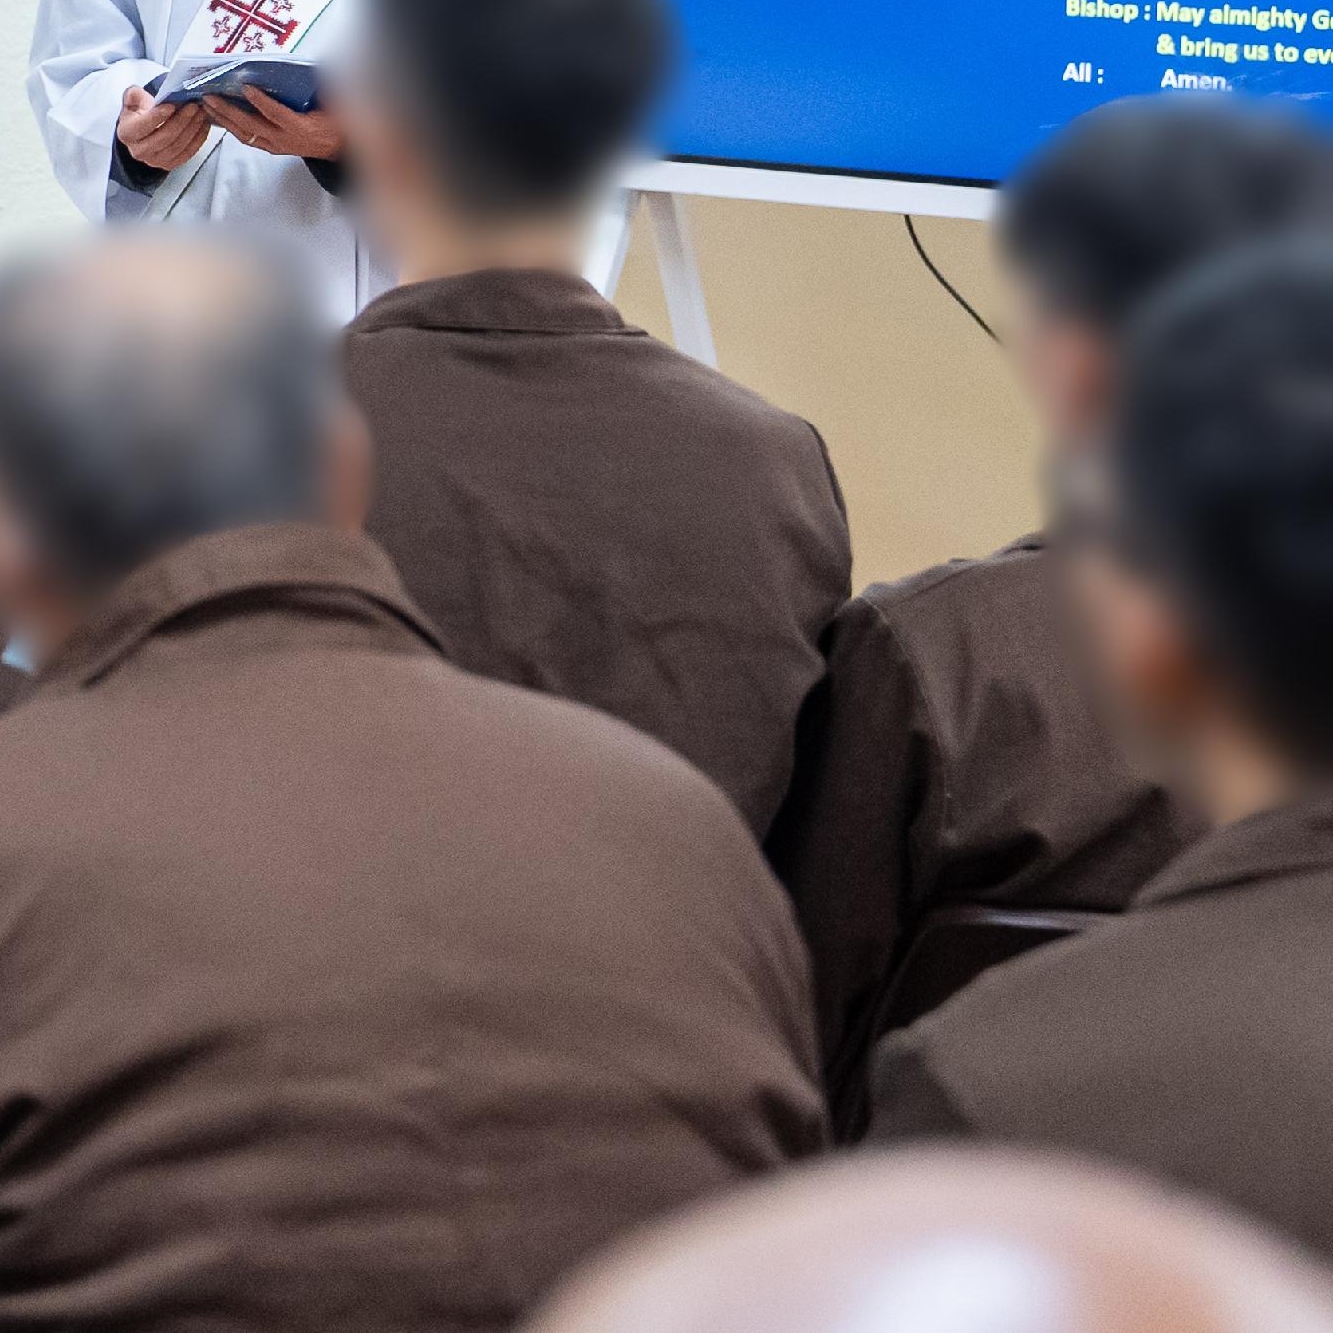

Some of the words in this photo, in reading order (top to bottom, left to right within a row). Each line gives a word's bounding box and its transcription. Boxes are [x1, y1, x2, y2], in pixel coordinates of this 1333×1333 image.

[1157, 1, 1205, 26] May
[1209, 5, 1307, 33] almighty
[1312, 10, 1333, 29] G
[1157, 34, 1175, 54] &
[1181, 36, 1237, 62] bring
[1244, 45, 1269, 60] us
[1275, 43, 1298, 62] to
[1063, 63, 1091, 82] All
